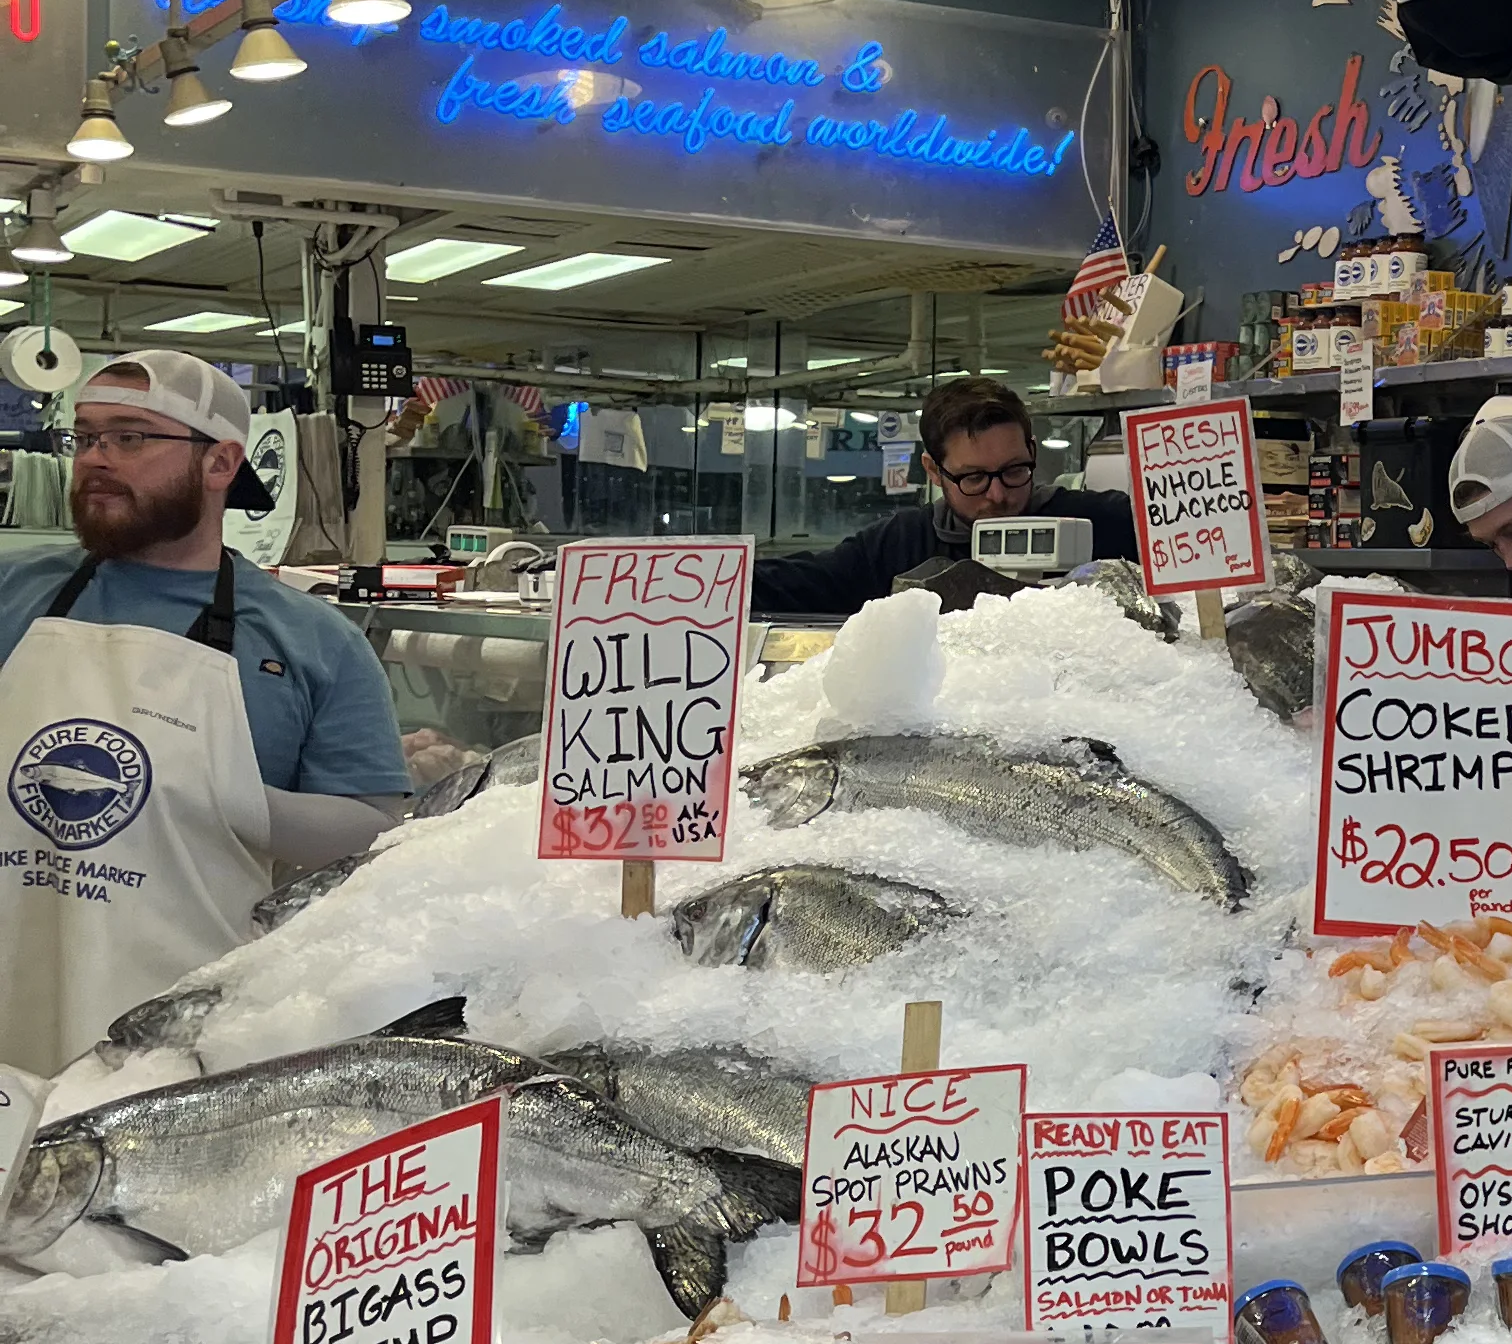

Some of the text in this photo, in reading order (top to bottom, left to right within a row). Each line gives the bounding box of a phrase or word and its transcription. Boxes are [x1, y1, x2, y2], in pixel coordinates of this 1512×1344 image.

[420, 3, 882, 92] smoked salmon &
[435, 55, 1075, 176] fresh seafood worldwide!
[1184, 53, 1383, 196] Fresh
[1140, 416, 1240, 462] FRESH
[1145, 462, 1238, 502] WHOLE
[1147, 490, 1253, 527] BLACKCOD
[1152, 526, 1227, 571] $15.99
[572, 552, 745, 612] FRESH
[562, 630, 730, 700] WILD
[29, 727, 141, 778] PURE FOOD
[561, 697, 726, 769] KING
[553, 760, 708, 805] SALMON
[18, 783, 129, 840] FISH MARKET
[75, 860, 146, 888] MARKET
[76, 882, 111, 903] WA.
[1469, 889, 1492, 902] per
[1444, 1060, 1495, 1081] PURE
[851, 1072, 971, 1119] NICE
[843, 1131, 960, 1170] ALASKAN
[1034, 1119, 1219, 1150] READY TO EAT
[322, 1143, 427, 1224] THE
[812, 1158, 1006, 1207] SPOT PRAWNS
[1044, 1166, 1211, 1216] POKE
[306, 1193, 477, 1290] ORIGINAL
[945, 1229, 994, 1267] pound
[1046, 1229, 1209, 1271] BOWLS
[1037, 1282, 1228, 1312] SALMON OR TUNA
